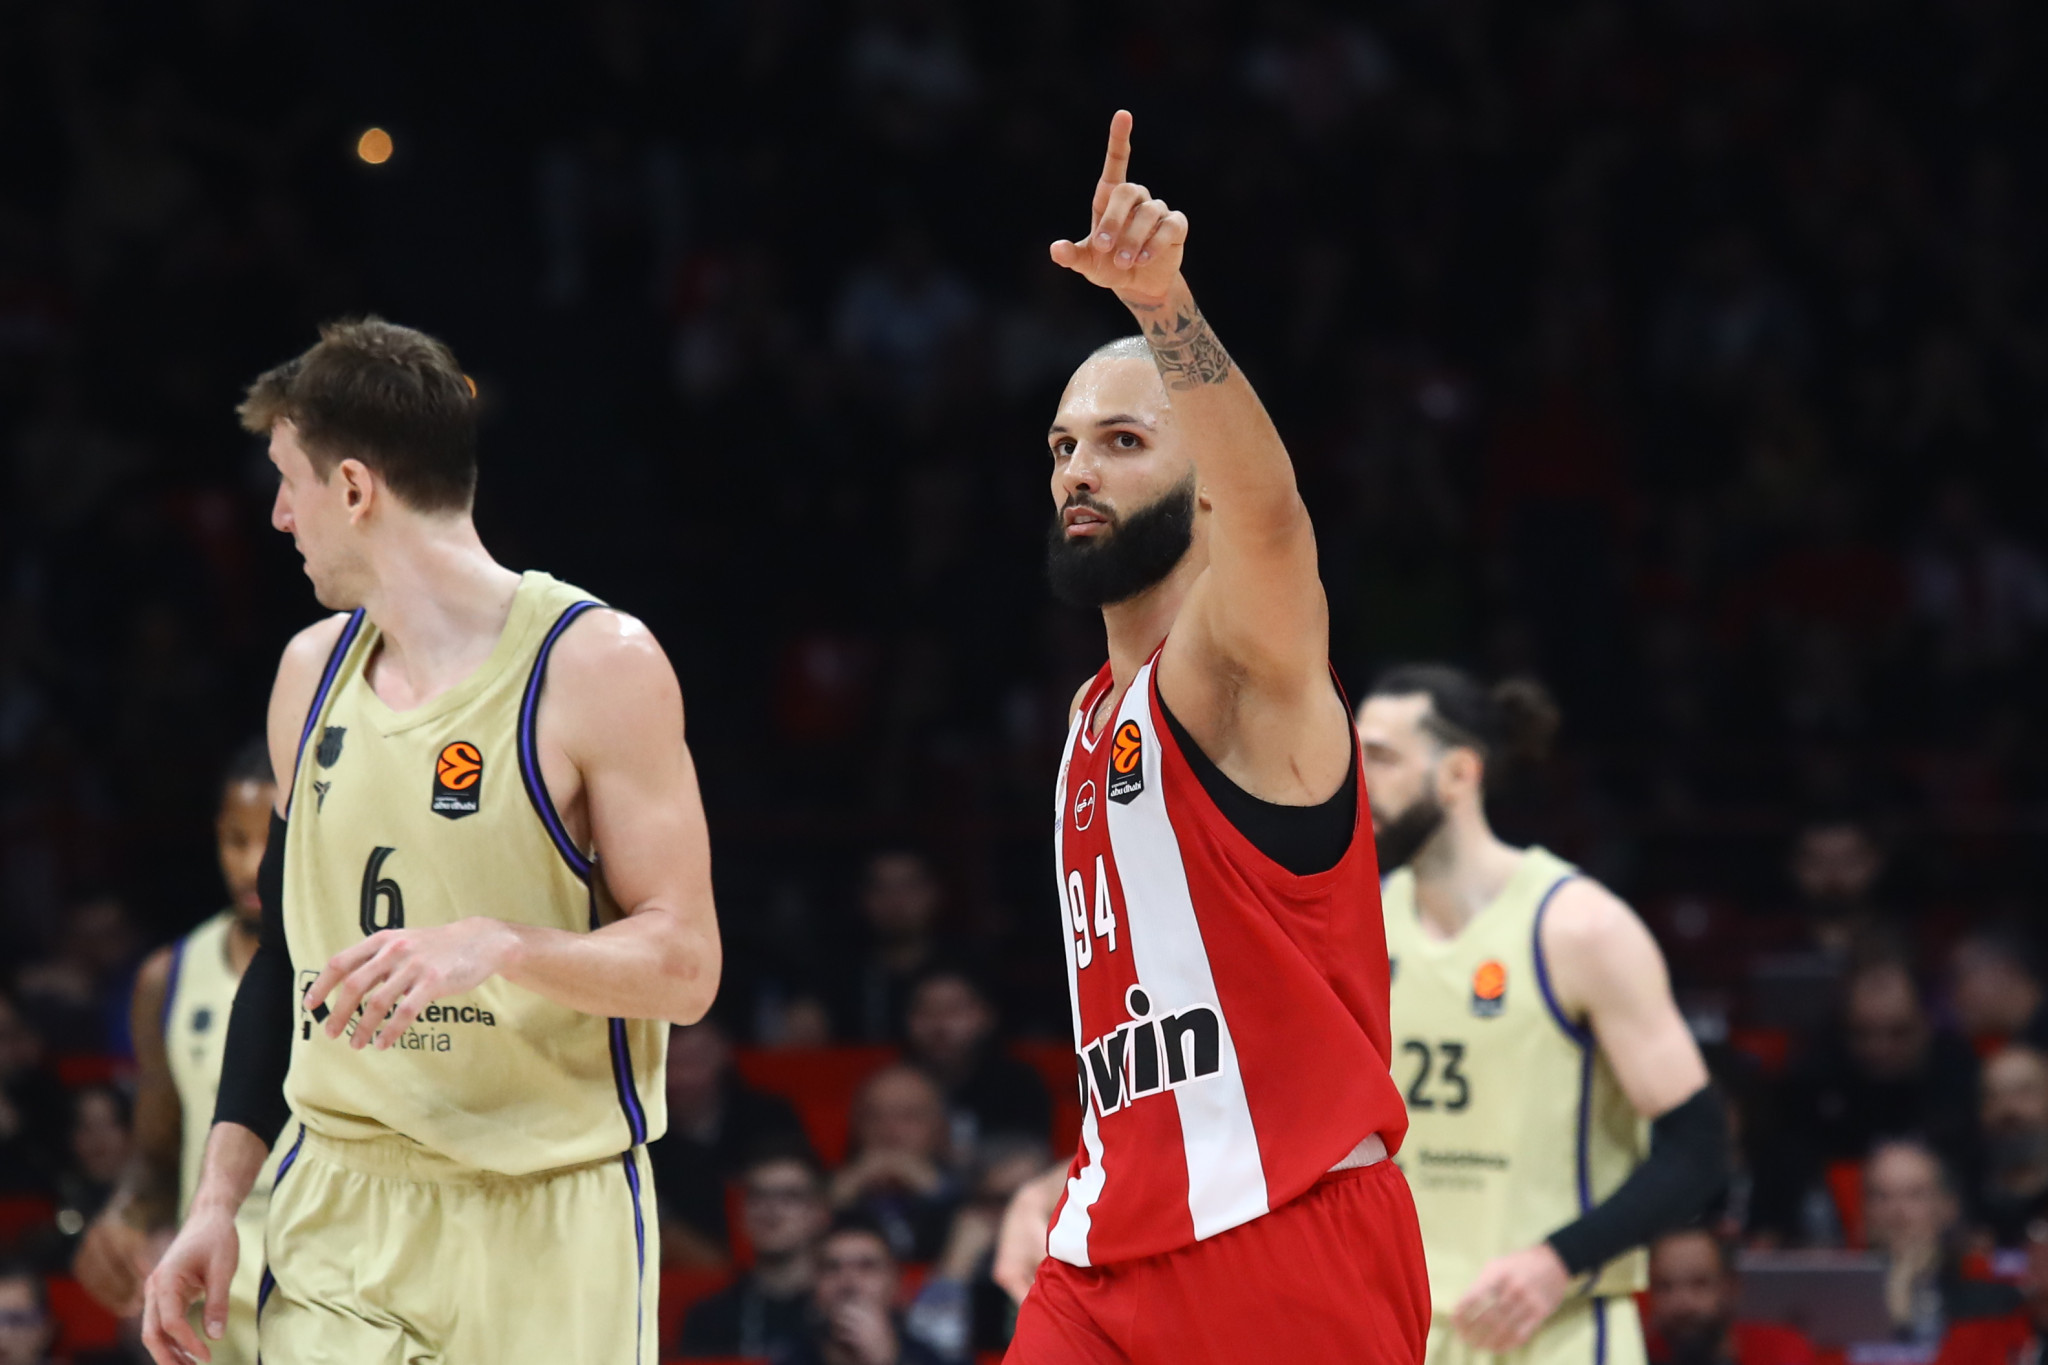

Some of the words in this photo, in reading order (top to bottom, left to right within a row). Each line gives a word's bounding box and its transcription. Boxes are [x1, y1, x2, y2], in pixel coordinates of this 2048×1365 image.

[360, 846, 405, 938] 6
[1067, 852, 1117, 970] 94
[346, 1017, 451, 1052] tària
[1402, 1039, 1471, 1113] 23
